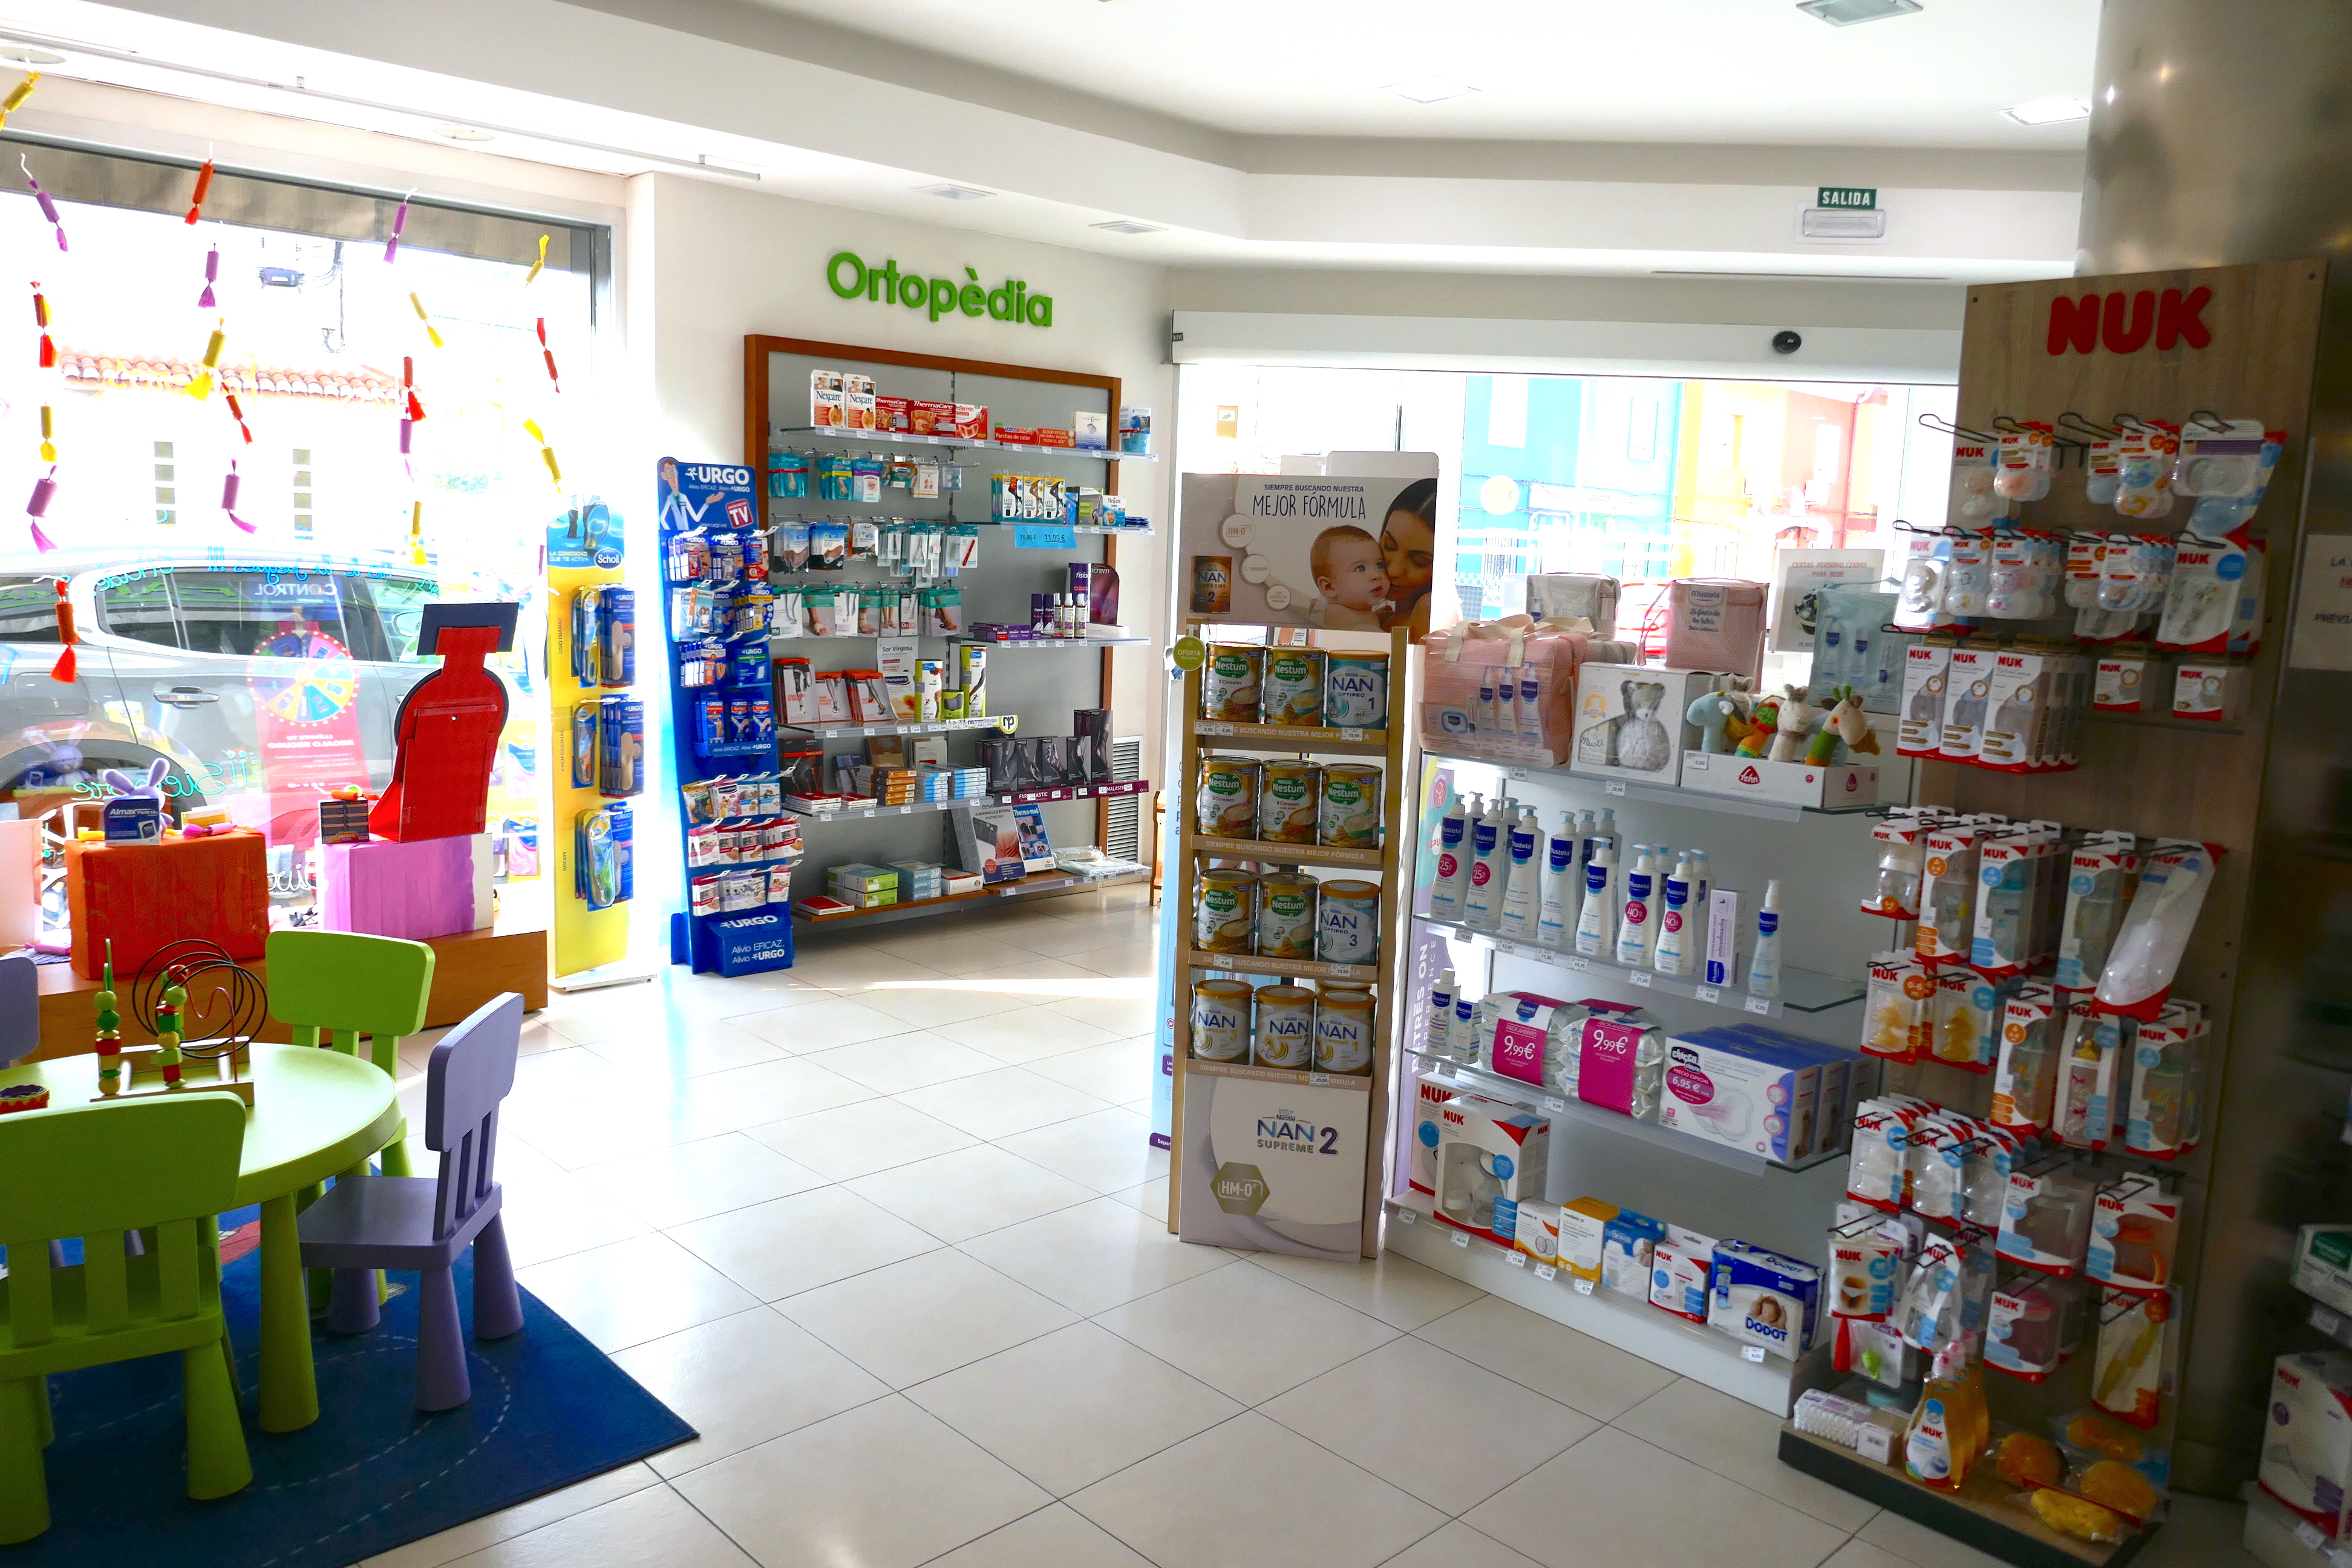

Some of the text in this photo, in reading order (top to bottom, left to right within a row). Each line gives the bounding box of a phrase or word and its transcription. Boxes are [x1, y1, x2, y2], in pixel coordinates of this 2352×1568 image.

[1822, 191, 1870, 206] SALIDA
[828, 252, 1053, 327] Ortopèdia
[2047, 287, 2212, 356] NUK
[817, 391, 841, 402] Nexcare
[850, 394, 873, 404] Nexcare
[914, 401, 953, 410] ThermaCare
[698, 466, 749, 485] URGO
[1252, 491, 1366, 520] MEJOR FÓRMULA
[729, 506, 748, 525] TV
[598, 555, 619, 564] Scholl
[1196, 571, 1227, 583] NAN
[1207, 591, 1215, 603] 2
[1909, 650, 1932, 660] NUK
[1953, 653, 1977, 664] NUK
[1216, 661, 1247, 671] Nestum
[1998, 656, 2023, 667] NUK
[1275, 665, 1307, 675] Nestum
[1332, 677, 1374, 692] NAN
[1368, 697, 1374, 710] 1
[1741, 771, 1759, 783] fehn
[1208, 779, 1240, 789] Nestum
[1272, 784, 1305, 794] Nestum
[1327, 788, 1359, 798] Nestum
[1013, 808, 1039, 817] Thermo-med
[1929, 838, 1952, 850] NUK
[1236, 843, 1272, 852] BUSCANDO
[1331, 850, 1364, 860] FÓRMULA
[1984, 848, 2008, 860] NUK
[1204, 895, 1235, 906] Nestum
[1272, 900, 1304, 910] Nestum
[730, 915, 777, 928] URGO
[1321, 910, 1357, 929] NAN
[1350, 934, 1357, 947] 3
[758, 949, 785, 960] URGO
[1419, 944, 1428, 979] ON
[1198, 1011, 1236, 1028] NAN
[1270, 1020, 1309, 1035] NAN
[1319, 1021, 1357, 1040] NAN
[1520, 1027, 1537, 1037] AHORRO
[1229, 1029, 1237, 1041] 3
[1304, 1035, 1309, 1046] 2
[1352, 1040, 1359, 1053] 1
[1672, 1048, 1697, 1063] chicco
[1199, 1064, 1355, 1086] SIEMPRE BUSCANDO NUESTRA RMULA
[1673, 1068, 1709, 1085] PRECIO ESPECIAL
[1673, 1077, 1691, 1089] 6,95
[1421, 1083, 1452, 1103] NUK
[1276, 1114, 1296, 1122] Nestlé
[1444, 1109, 1464, 1125] NUK
[1257, 1119, 1316, 1143] NAN
[1257, 1138, 1314, 1154] SUPREME
[1319, 1126, 1339, 1155] 2
[2010, 1175, 2035, 1191] NUK
[1520, 1210, 1533, 1220] medela
[1564, 1212, 1579, 1221] medela
[1656, 1250, 1672, 1262] NUK
[1922, 1425, 1942, 1439] NUK
